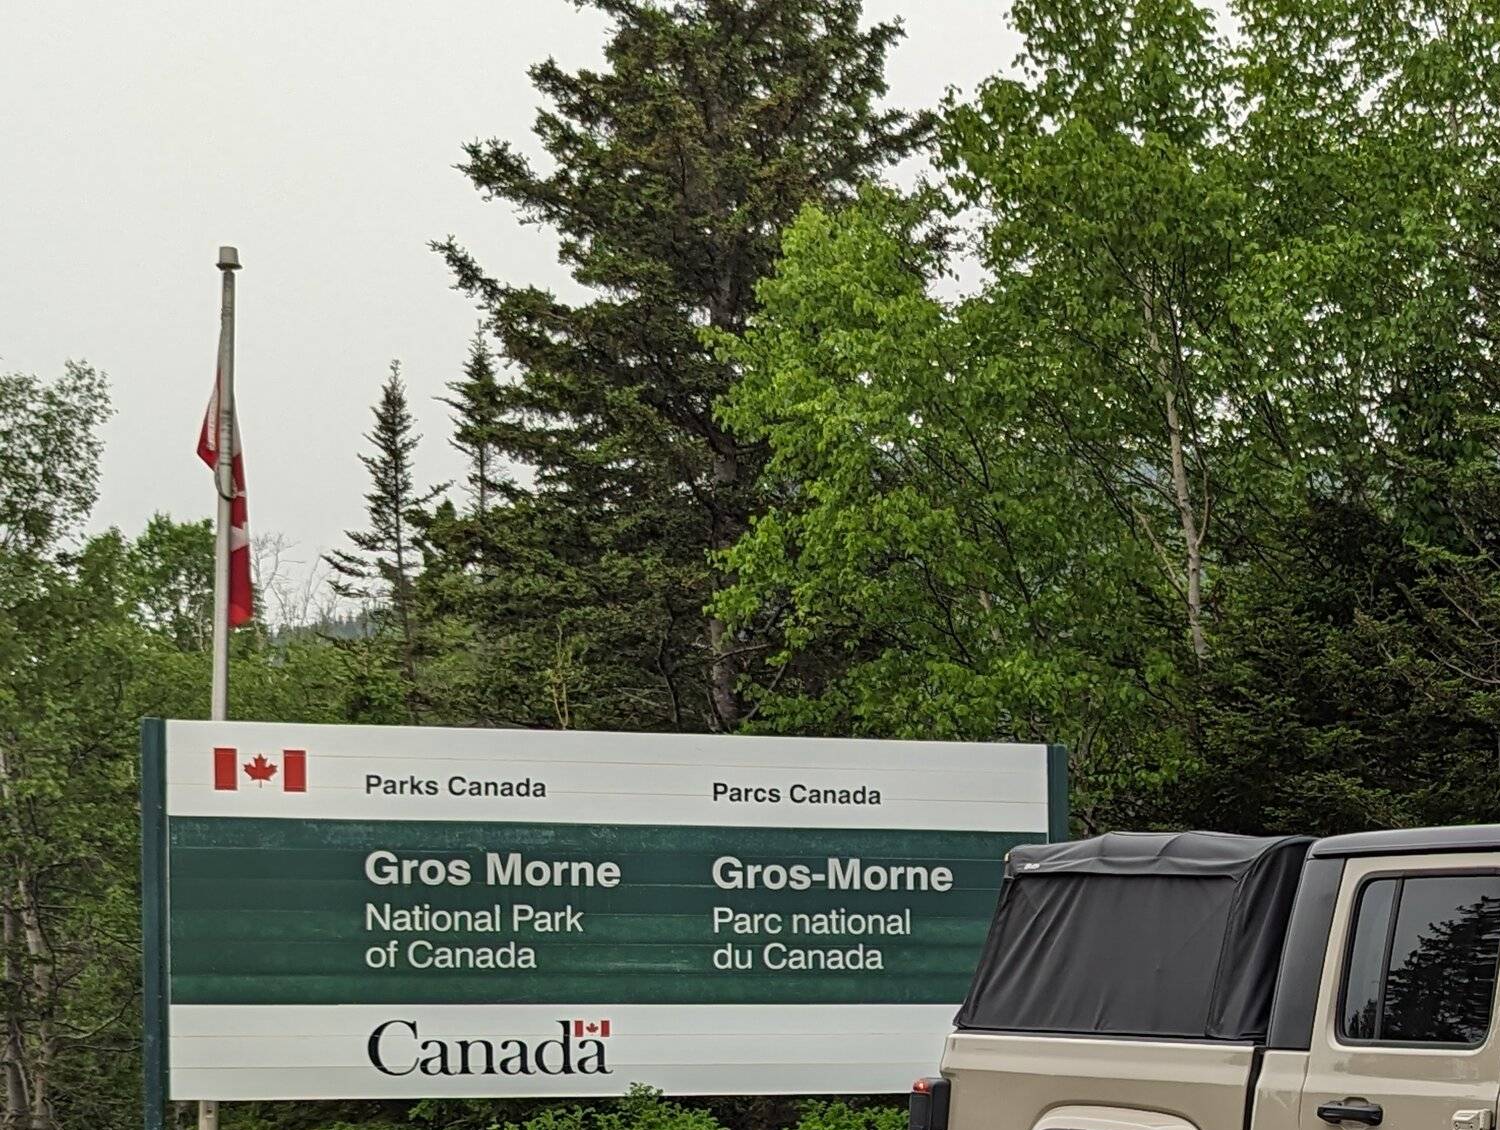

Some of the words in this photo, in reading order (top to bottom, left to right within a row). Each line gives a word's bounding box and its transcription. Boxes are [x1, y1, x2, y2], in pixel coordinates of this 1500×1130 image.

[365, 774, 439, 797] Parks
[448, 776, 547, 798] Canada
[712, 782, 782, 803] Parcs
[789, 783, 882, 805] Canada
[365, 851, 473, 887] Gros
[486, 853, 622, 888] Morne
[712, 856, 954, 892] Gros-Morne
[366, 902, 501, 933] National
[513, 905, 584, 933] Park
[713, 906, 784, 935] Parc
[792, 907, 912, 936] national
[365, 940, 400, 969] of
[407, 941, 537, 970] Canada
[713, 943, 754, 971] du
[763, 943, 885, 971] Canada
[367, 1019, 613, 1077] Canada
